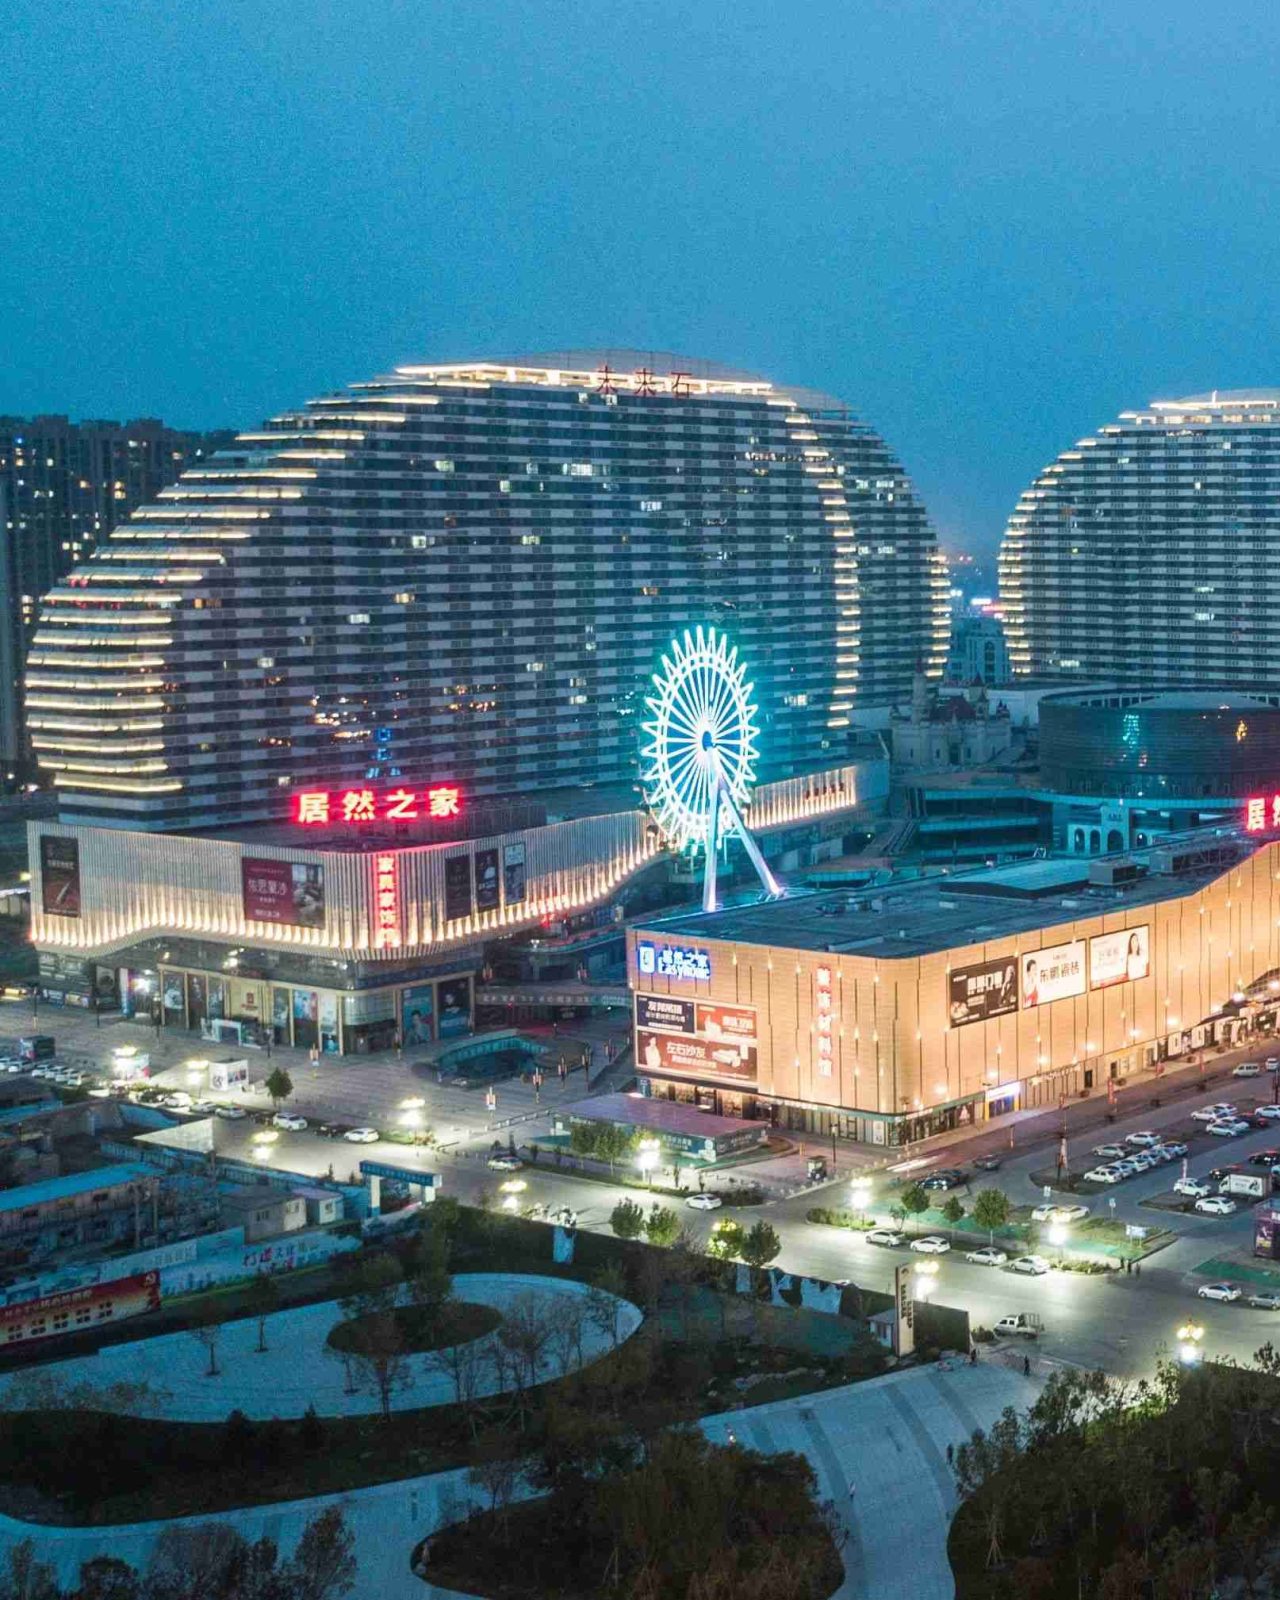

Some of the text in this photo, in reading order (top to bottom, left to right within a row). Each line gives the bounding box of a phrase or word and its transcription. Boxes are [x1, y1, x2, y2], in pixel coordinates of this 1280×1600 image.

[298, 787, 460, 824] 居然之家
[1039, 960, 1081, 983] 东鹏瓷砖
